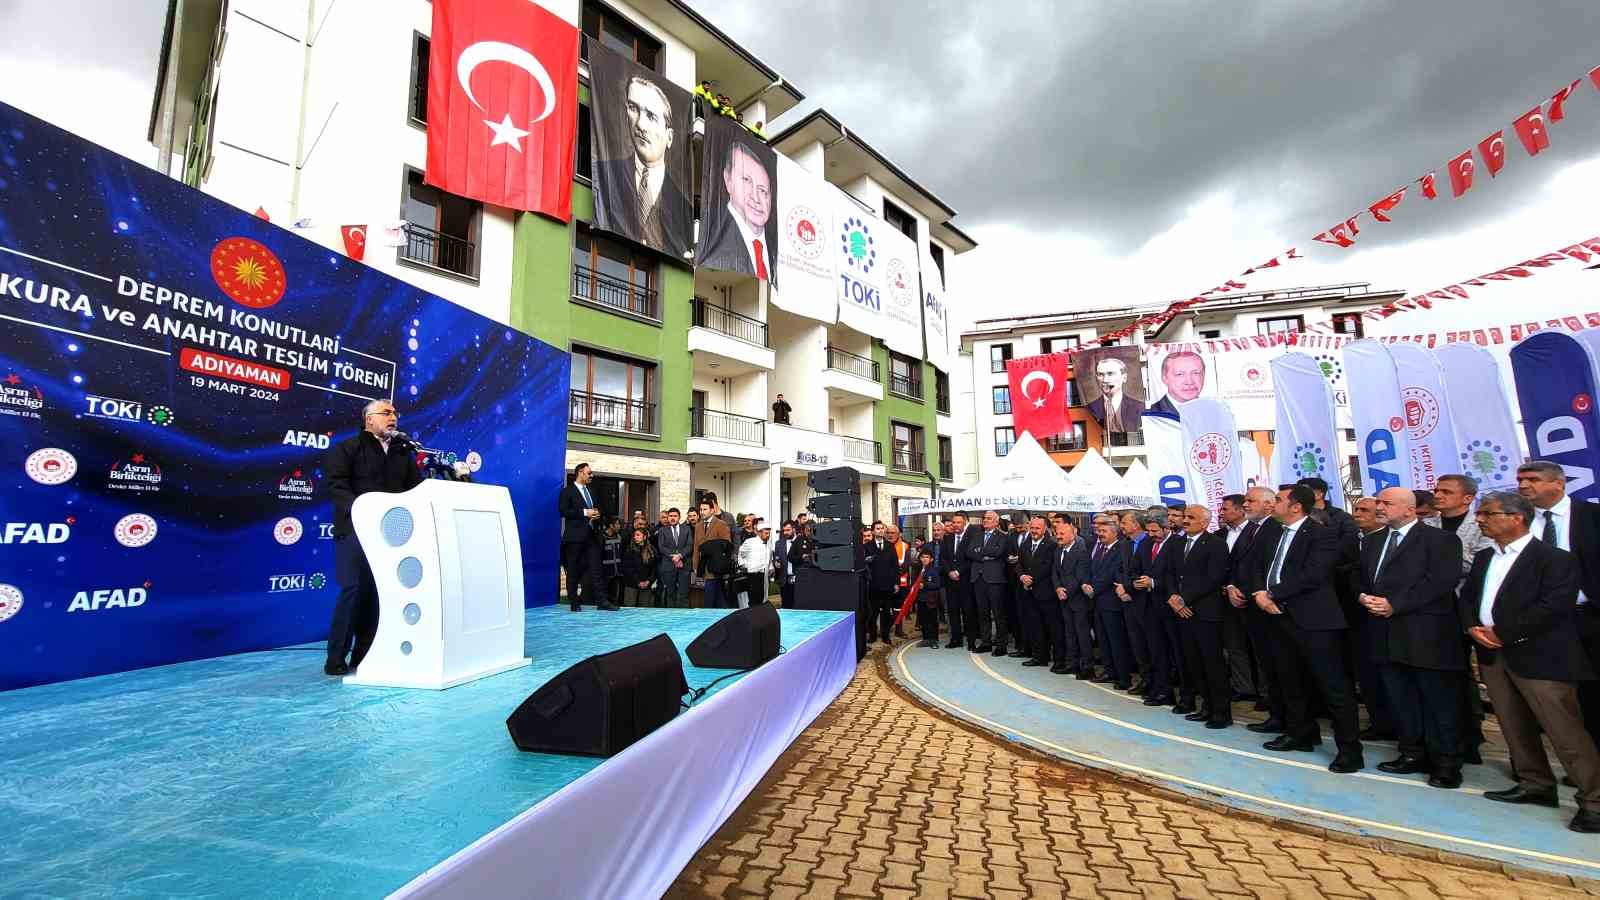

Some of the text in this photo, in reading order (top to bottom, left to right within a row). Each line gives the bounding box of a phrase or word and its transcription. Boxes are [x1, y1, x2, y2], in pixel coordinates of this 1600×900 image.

[118, 275, 224, 322] DEPREM
[841, 274, 880, 311] TOKİ
[0, 273, 389, 389] KURA ve ANAHTAR TESLİM TÖRENİ
[191, 354, 281, 385] ADIYAMAN
[190, 376, 280, 401] 19 MART 2024
[85, 396, 142, 420] TOKİ
[283, 430, 330, 449] AFAD
[123, 464, 150, 472] Asrın
[923, 497, 982, 510] ADIYAMAN
[0, 522, 70, 544] FAD
[269, 575, 305, 590] TOKİ
[67, 587, 147, 612] AFAD
